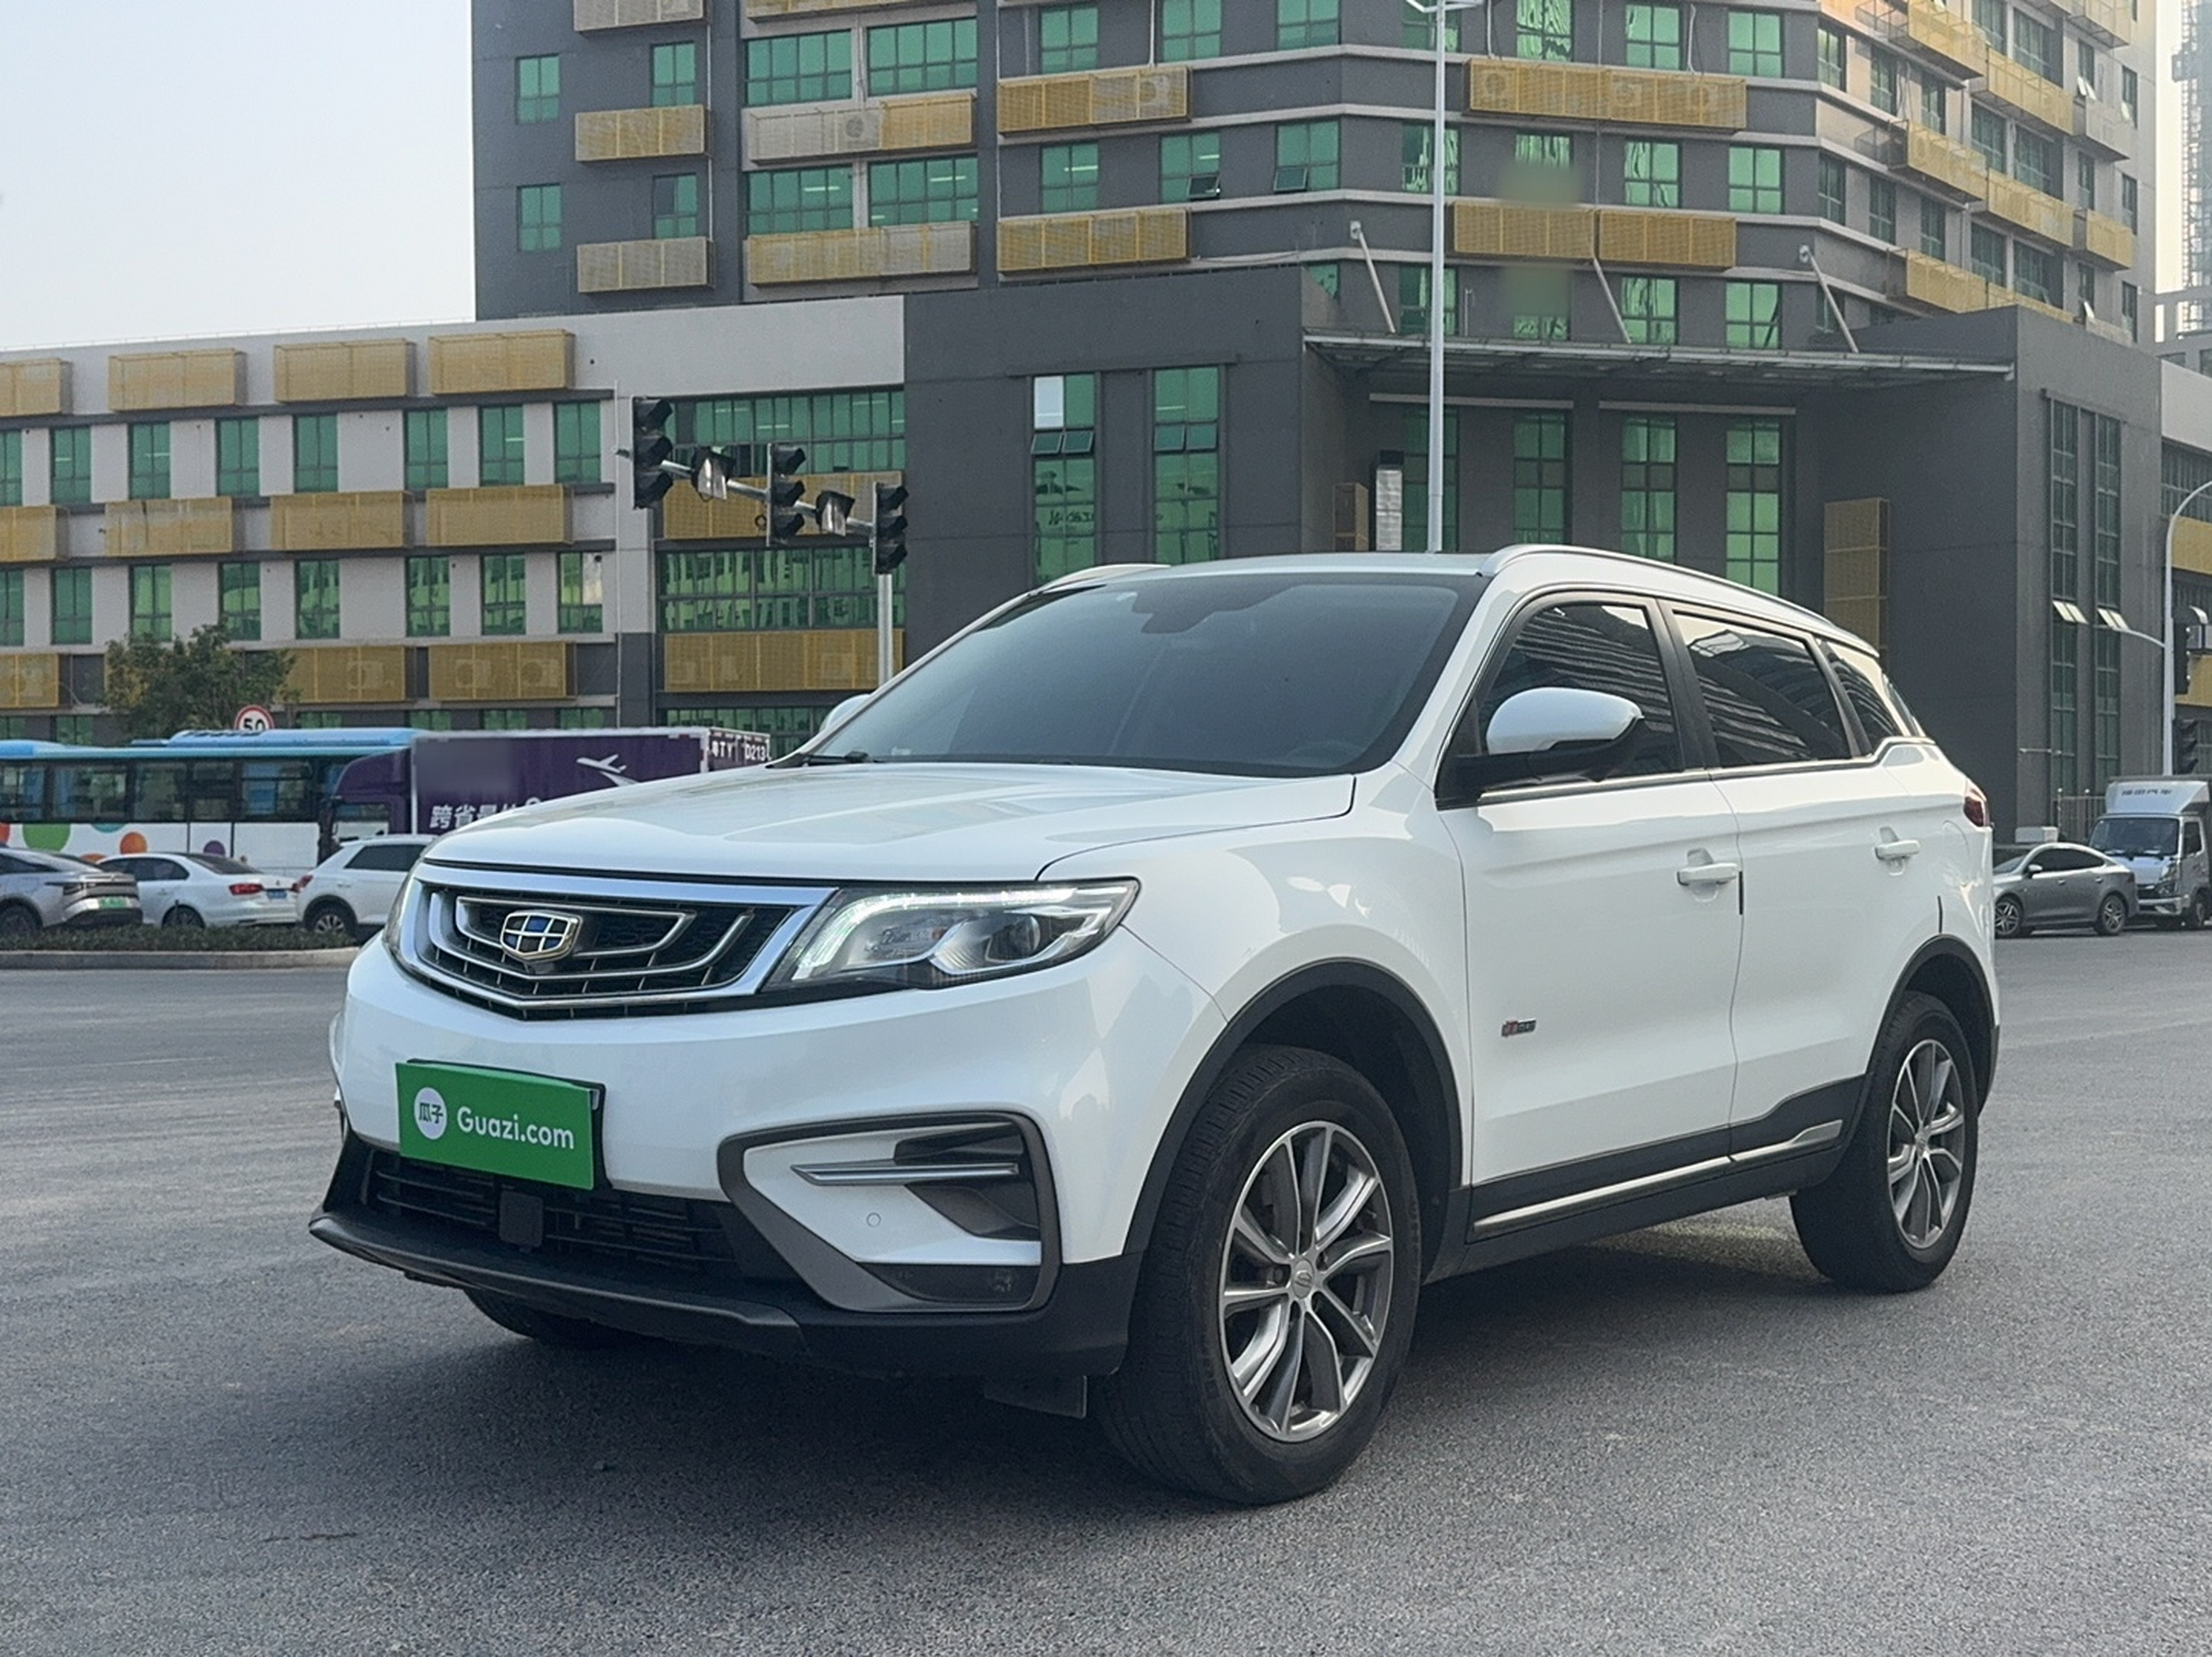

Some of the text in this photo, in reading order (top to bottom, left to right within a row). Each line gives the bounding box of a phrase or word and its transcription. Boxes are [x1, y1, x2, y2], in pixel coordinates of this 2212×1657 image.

[244, 718, 266, 731] 50
[419, 1102, 574, 1149] 瓜子 Guazi.com
